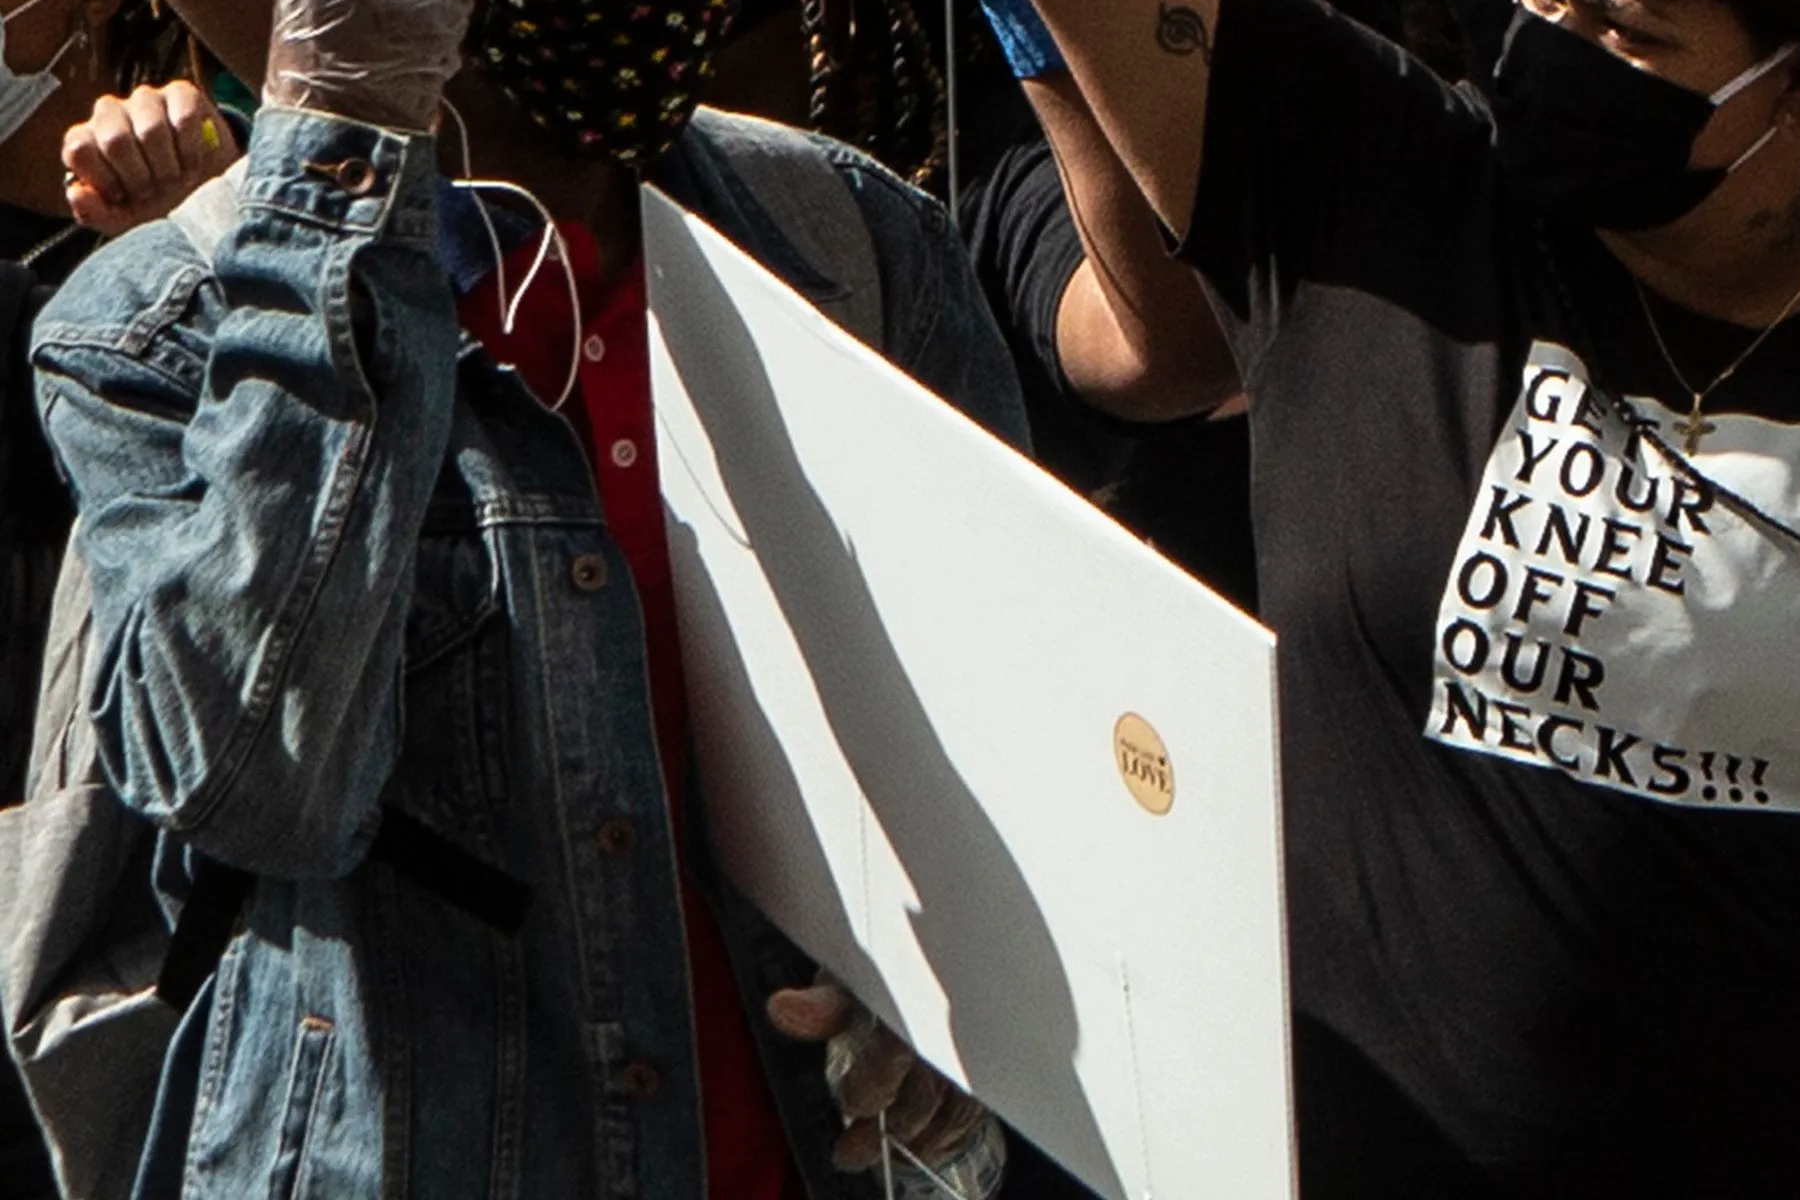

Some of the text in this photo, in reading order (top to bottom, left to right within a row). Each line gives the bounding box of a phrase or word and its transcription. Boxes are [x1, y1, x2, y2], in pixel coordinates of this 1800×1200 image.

[1514, 428, 1717, 535] YOUR
[1479, 484, 1695, 596] KNEE
[1457, 551, 1617, 637] OFF
[1442, 617, 1606, 710] OUR
[1439, 681, 1770, 805] NECKS!!!
